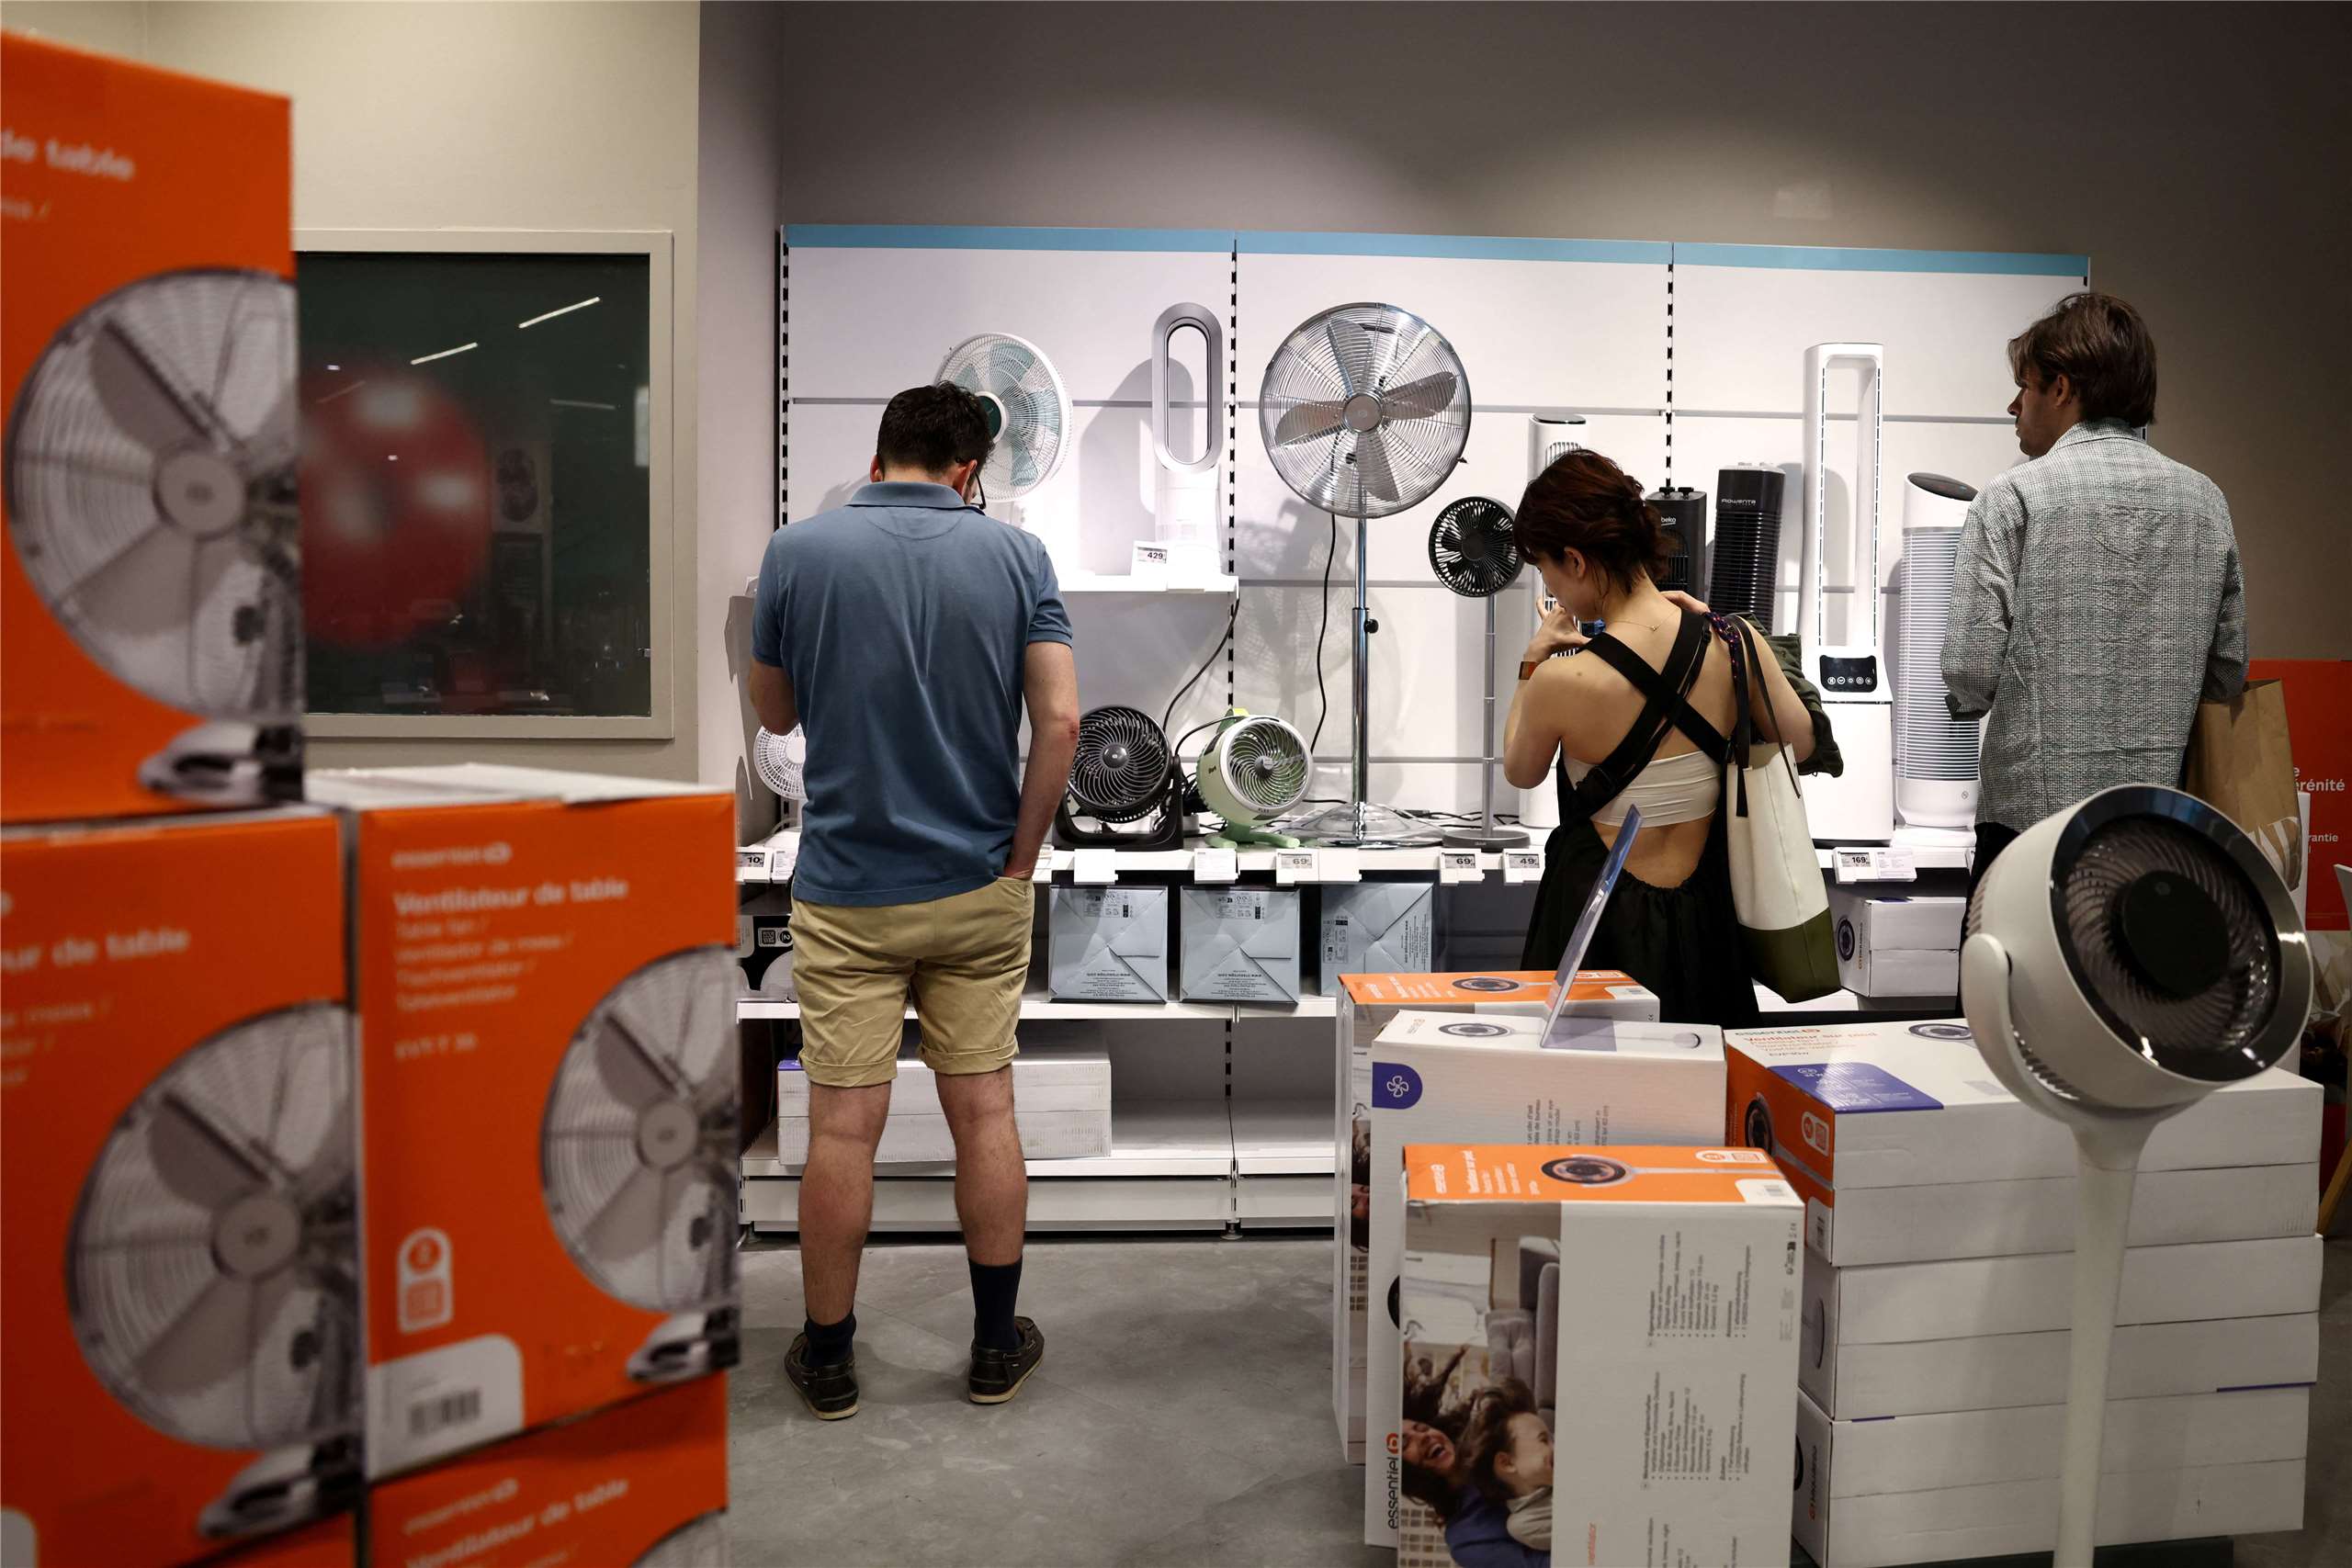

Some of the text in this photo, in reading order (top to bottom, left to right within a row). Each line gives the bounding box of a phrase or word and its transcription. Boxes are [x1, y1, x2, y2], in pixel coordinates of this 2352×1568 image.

[2293, 779, 2346, 792] rénité
[2308, 832, 2338, 842] rantie
[1387, 1457, 1398, 1529] essentiel
